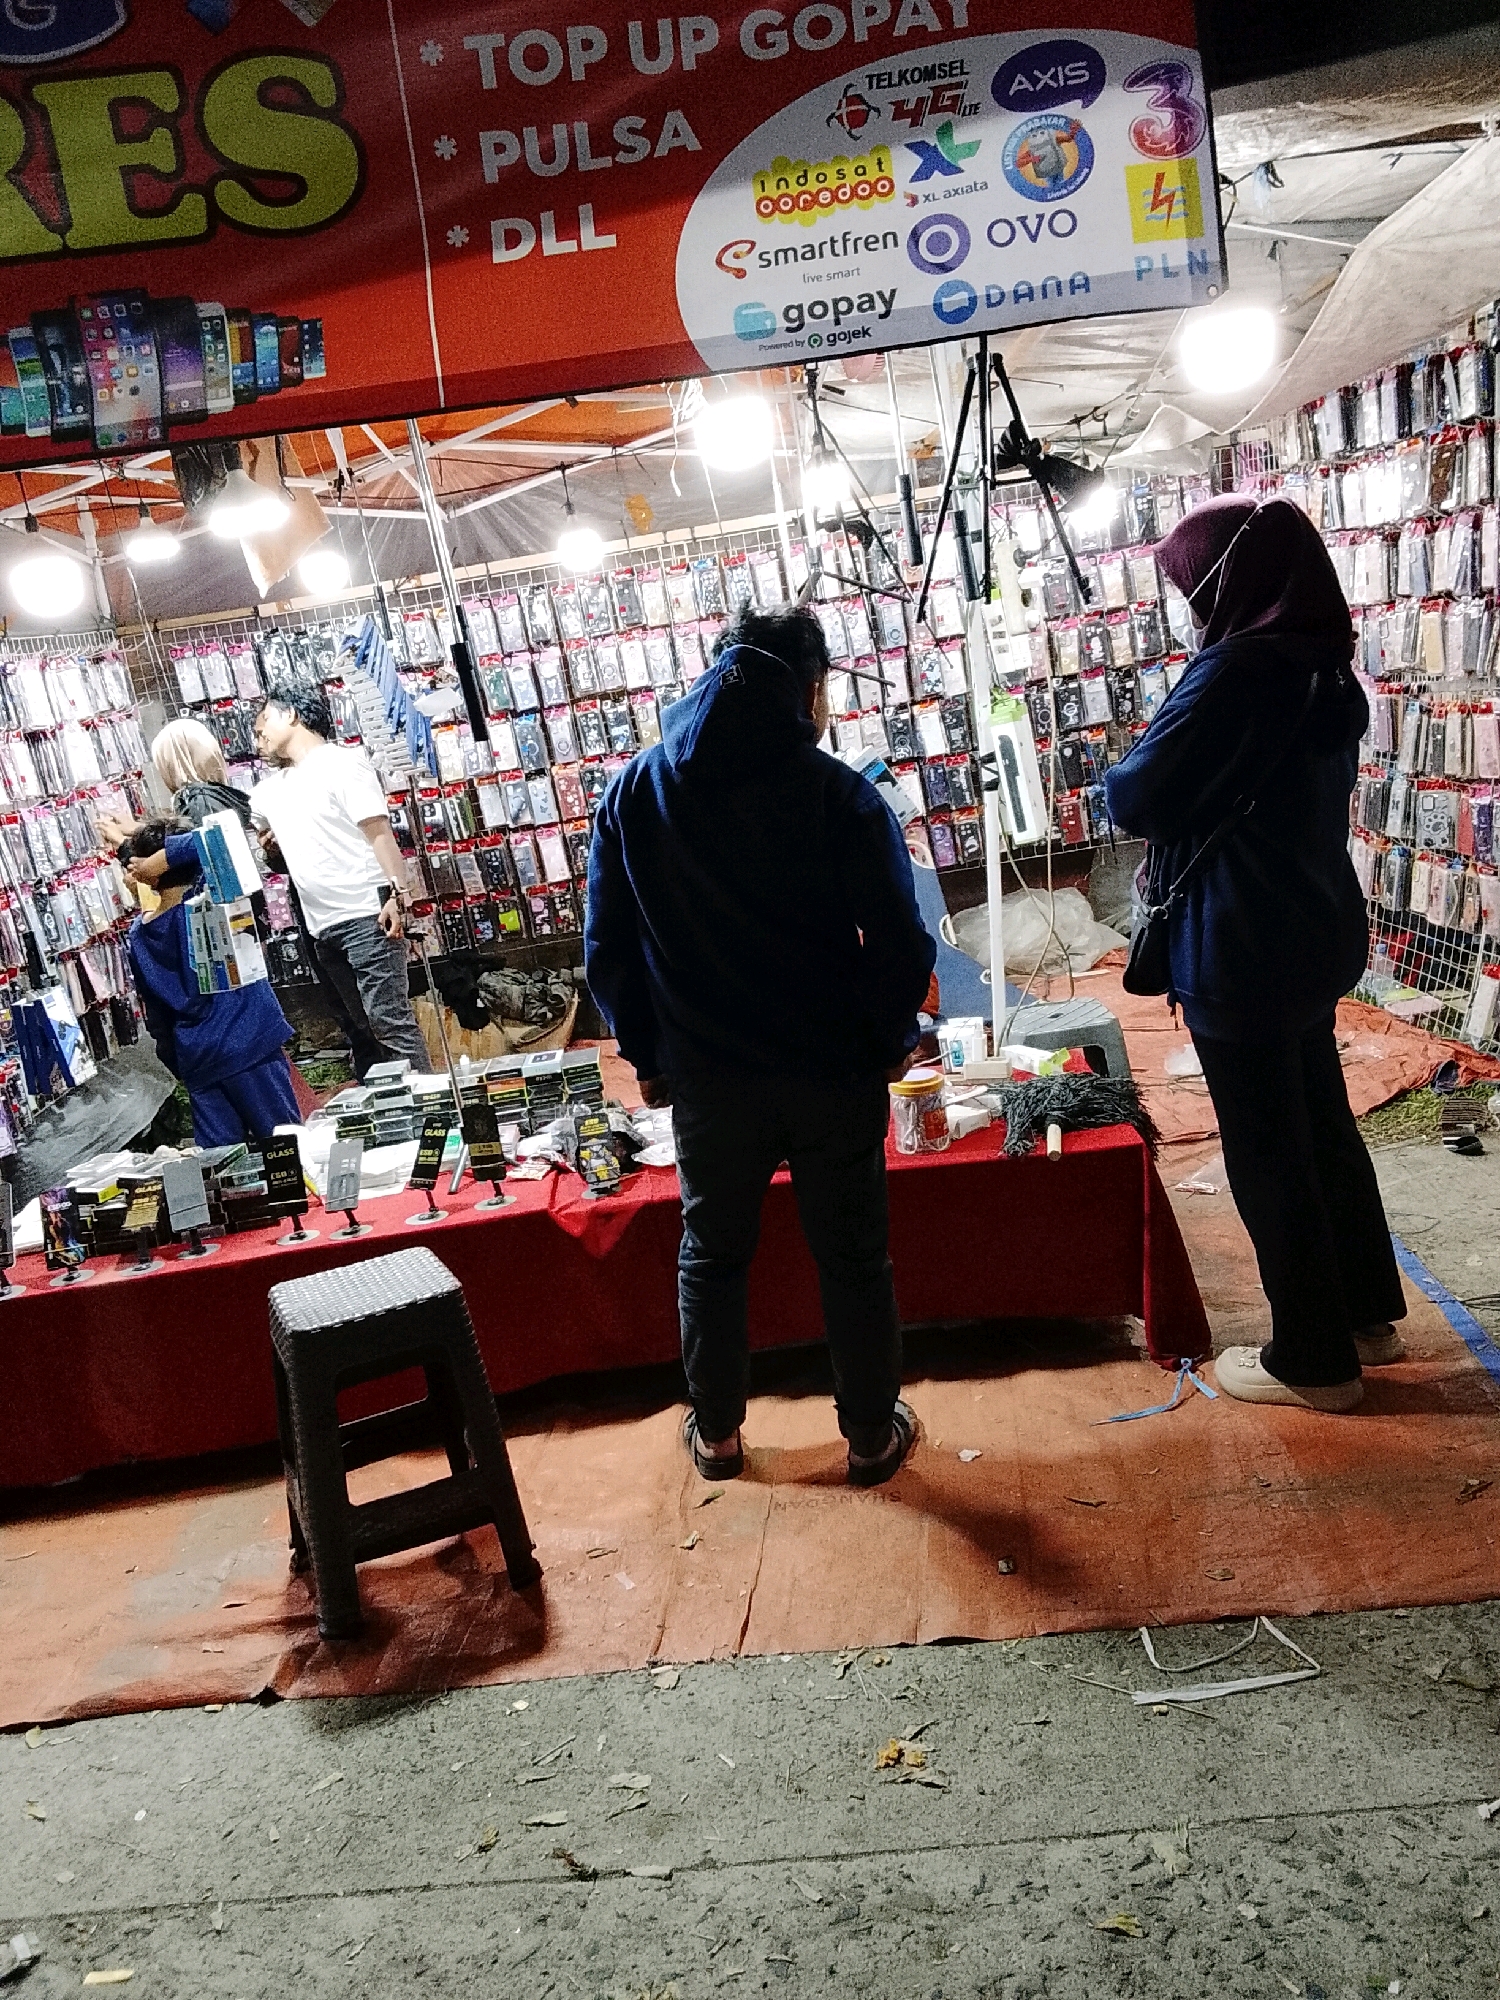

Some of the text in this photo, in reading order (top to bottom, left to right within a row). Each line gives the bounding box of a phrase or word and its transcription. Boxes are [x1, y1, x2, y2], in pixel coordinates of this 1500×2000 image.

[463, 0, 972, 90] TOP UP GOPAY
[866, 59, 970, 90] TELKOMSEL
[1008, 60, 1090, 97] AXIS
[961, 102, 981, 118] LTE
[1122, 59, 1207, 160] 3
[478, 110, 702, 185] PULSA
[903, 119, 983, 184] XL
[760, 156, 886, 193] indosat
[922, 180, 989, 204] XL axiata
[757, 177, 894, 217] ooredoo
[490, 204, 617, 264] DLL
[986, 207, 1078, 248] OVO
[758, 230, 899, 270] smartfren
[1133, 248, 1210, 282] PLN
[802, 267, 861, 284] live smart
[984, 271, 1091, 309] DANA
[782, 287, 898, 334] gopay
[758, 325, 873, 352] Powered by gojek
[424, 1128, 447, 1137] GLASS
[266, 1147, 295, 1160] GLASS
